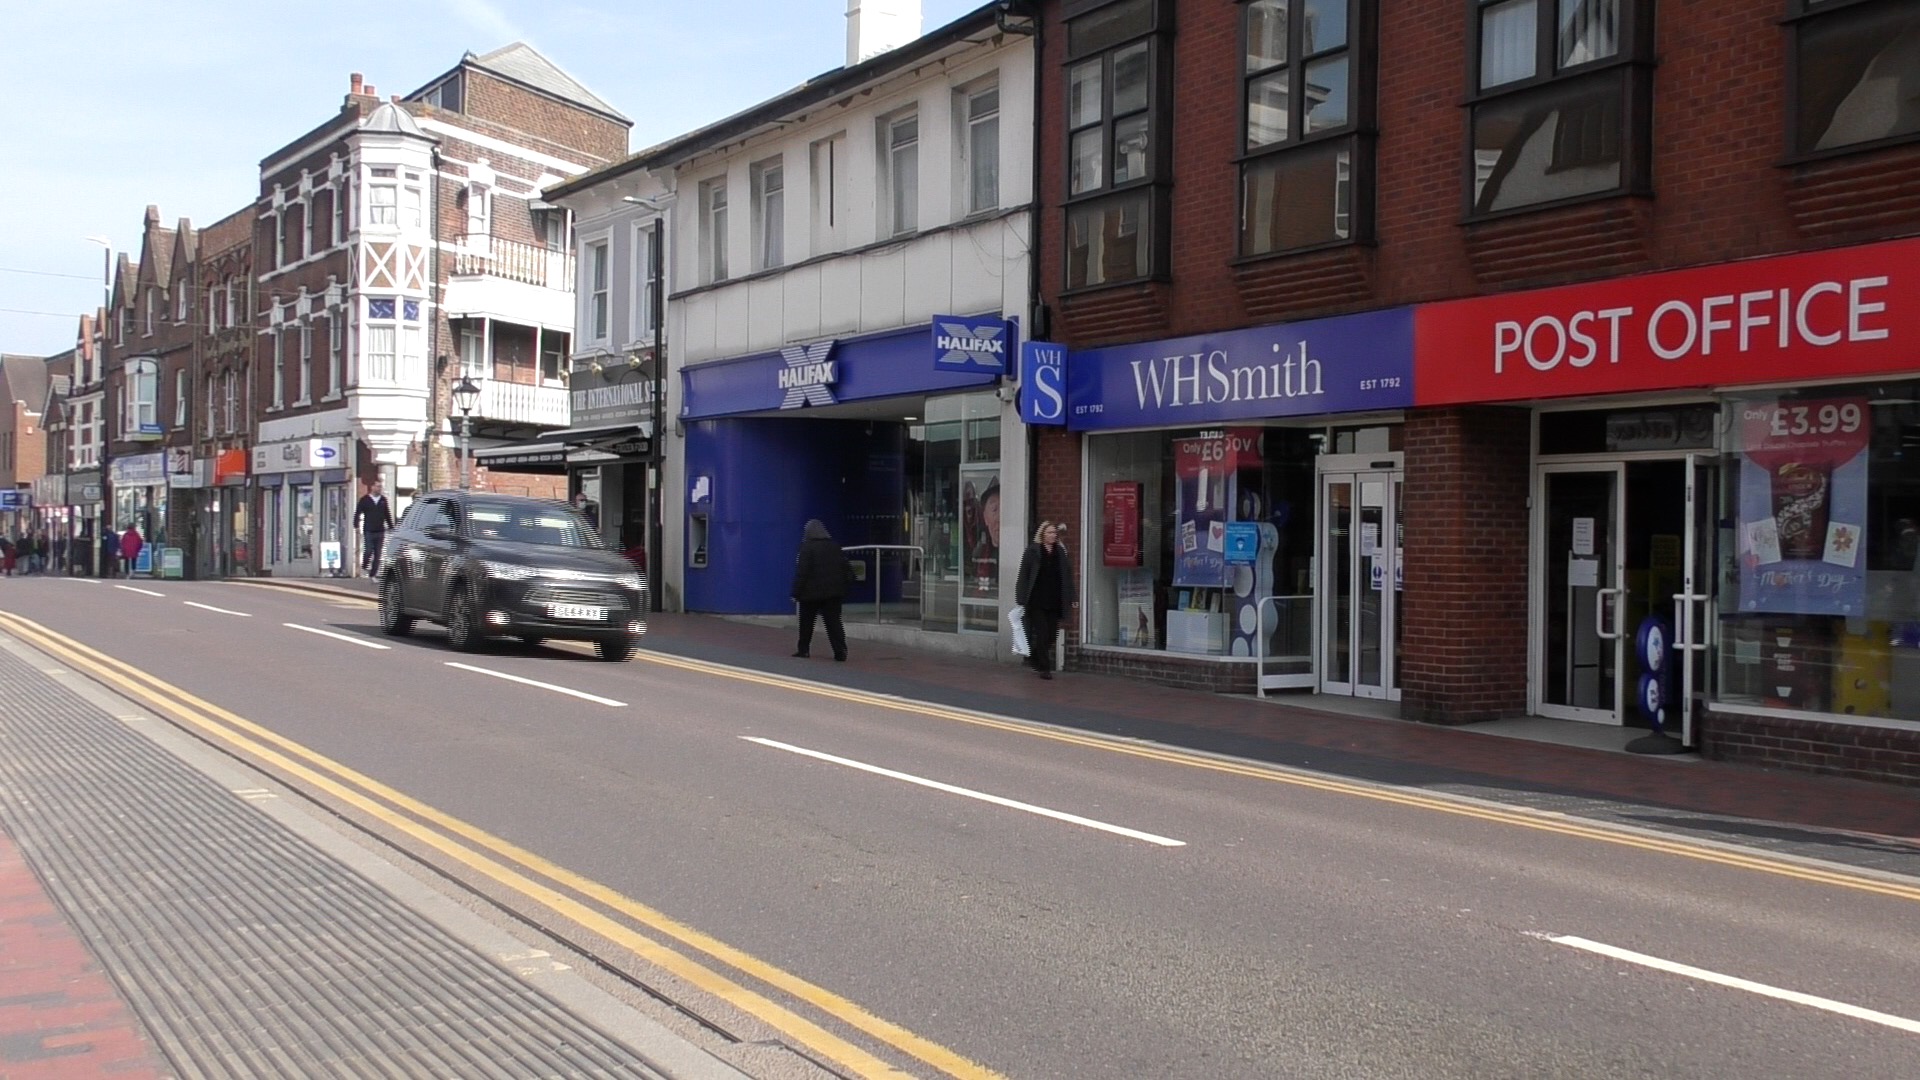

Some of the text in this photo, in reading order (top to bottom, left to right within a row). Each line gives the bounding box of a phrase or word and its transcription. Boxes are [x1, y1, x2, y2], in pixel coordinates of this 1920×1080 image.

[1494, 275, 1889, 374] POST OFFICE
[937, 335, 1003, 354] HALIFAX
[1034, 348, 1062, 365] WH
[778, 361, 834, 389] HALIFAX
[1131, 340, 1325, 410] WHSmith
[1360, 377, 1401, 391] EST 1792
[573, 379, 667, 411] THE INTERNATIONAL SP
[1033, 364, 1063, 419] S
[1743, 403, 1861, 436] Only £3.99
